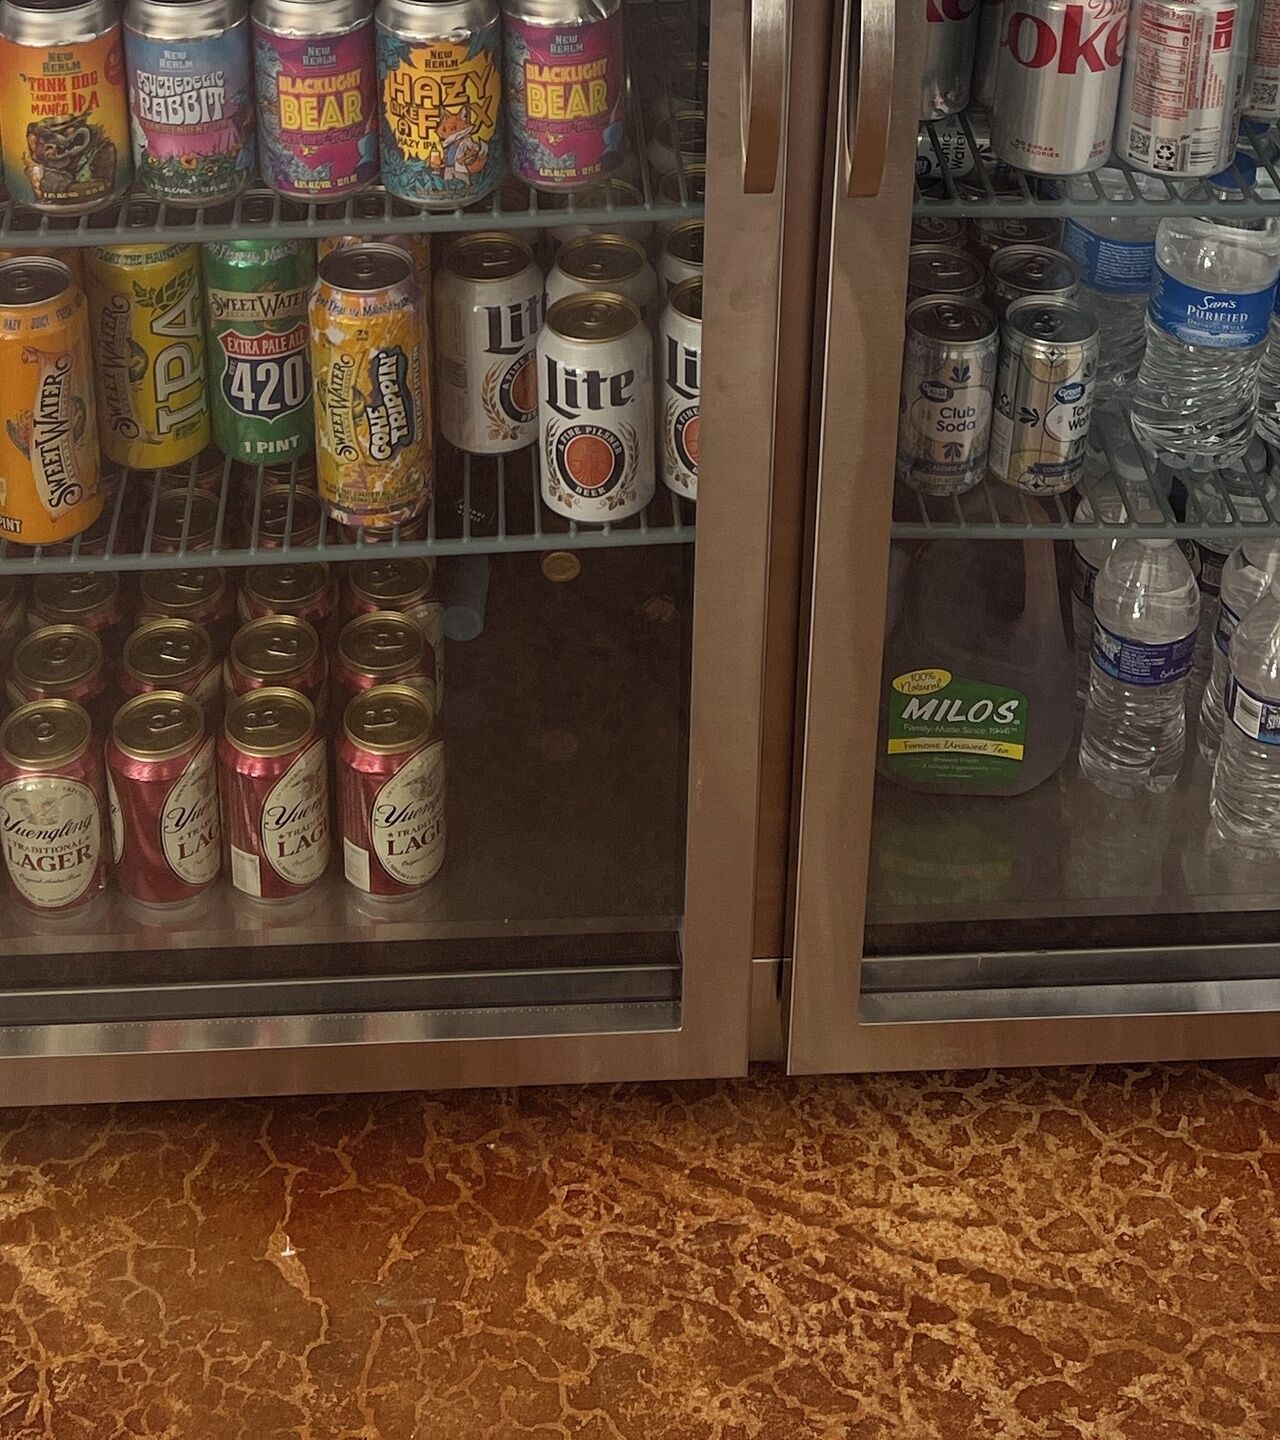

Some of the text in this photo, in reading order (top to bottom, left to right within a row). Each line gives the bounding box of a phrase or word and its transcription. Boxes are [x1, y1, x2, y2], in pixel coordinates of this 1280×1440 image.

[555, 35, 578, 44] NEW
[1007, 3, 1125, 75] oke
[163, 50, 187, 60] NEW
[307, 46, 330, 57] NEW
[430, 50, 453, 60] NEW
[28, 70, 99, 92] TANK DOG
[526, 58, 608, 81] BLACKLIGHT
[136, 69, 225, 98] PSYCHEDELIC
[278, 68, 362, 95] BLACKLIGHT
[389, 65, 492, 107] HAZY
[72, 90, 100, 113] IPA
[138, 86, 226, 126] RABBIT
[526, 78, 610, 120] BEAR
[279, 90, 363, 133] BEAR
[397, 121, 410, 138] A
[398, 136, 437, 151] HAZY IPA
[1186, 304, 1248, 323] PURIFIED
[1198, 296, 1237, 311] Sam's
[484, 293, 542, 356] Lit
[227, 329, 306, 353] EXTRA PALE ALE
[151, 272, 207, 437] IPA
[230, 359, 304, 411] 420
[545, 353, 636, 420] Lite
[367, 352, 409, 460] GONE TRIPPIN'
[940, 406, 976, 419] Club
[936, 419, 976, 432] Soda
[243, 436, 301, 455] 1 PINT
[563, 428, 581, 444] FINE
[585, 426, 623, 456] PILSNER
[575, 486, 606, 497] BEER
[900, 679, 942, 693] Natural
[901, 697, 1020, 725] MILOS
[902, 740, 1009, 754] Famous Unsweet Tea
[0, 805, 93, 844] Yuengling
[13, 837, 84, 855] TRADITIONAL
[8, 844, 94, 872] LAGER
